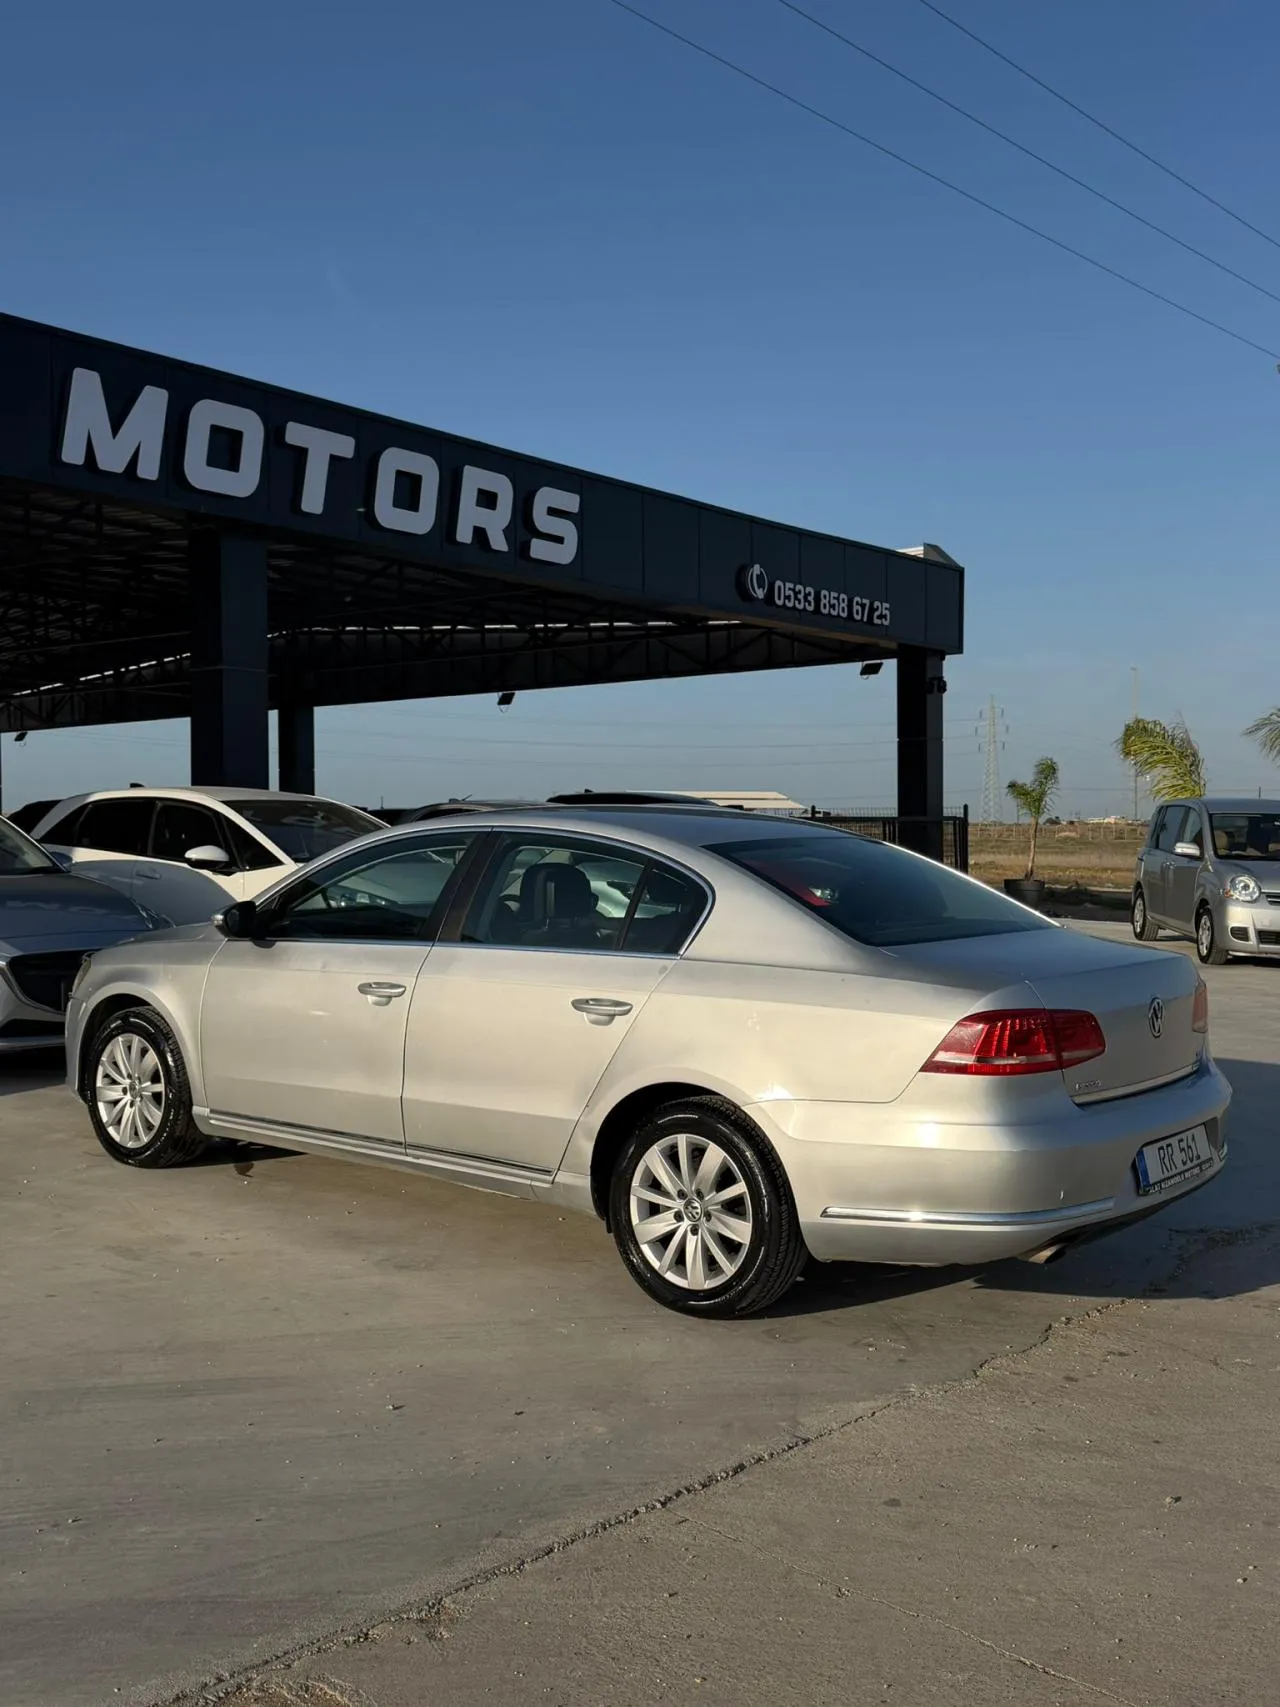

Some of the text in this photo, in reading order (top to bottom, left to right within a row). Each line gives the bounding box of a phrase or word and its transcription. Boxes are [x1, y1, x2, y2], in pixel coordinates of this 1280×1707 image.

[61, 367, 581, 565] MOTORS
[774, 580, 890, 626] 0533 858 67 25
[1158, 1133, 1200, 1175] RR 561
